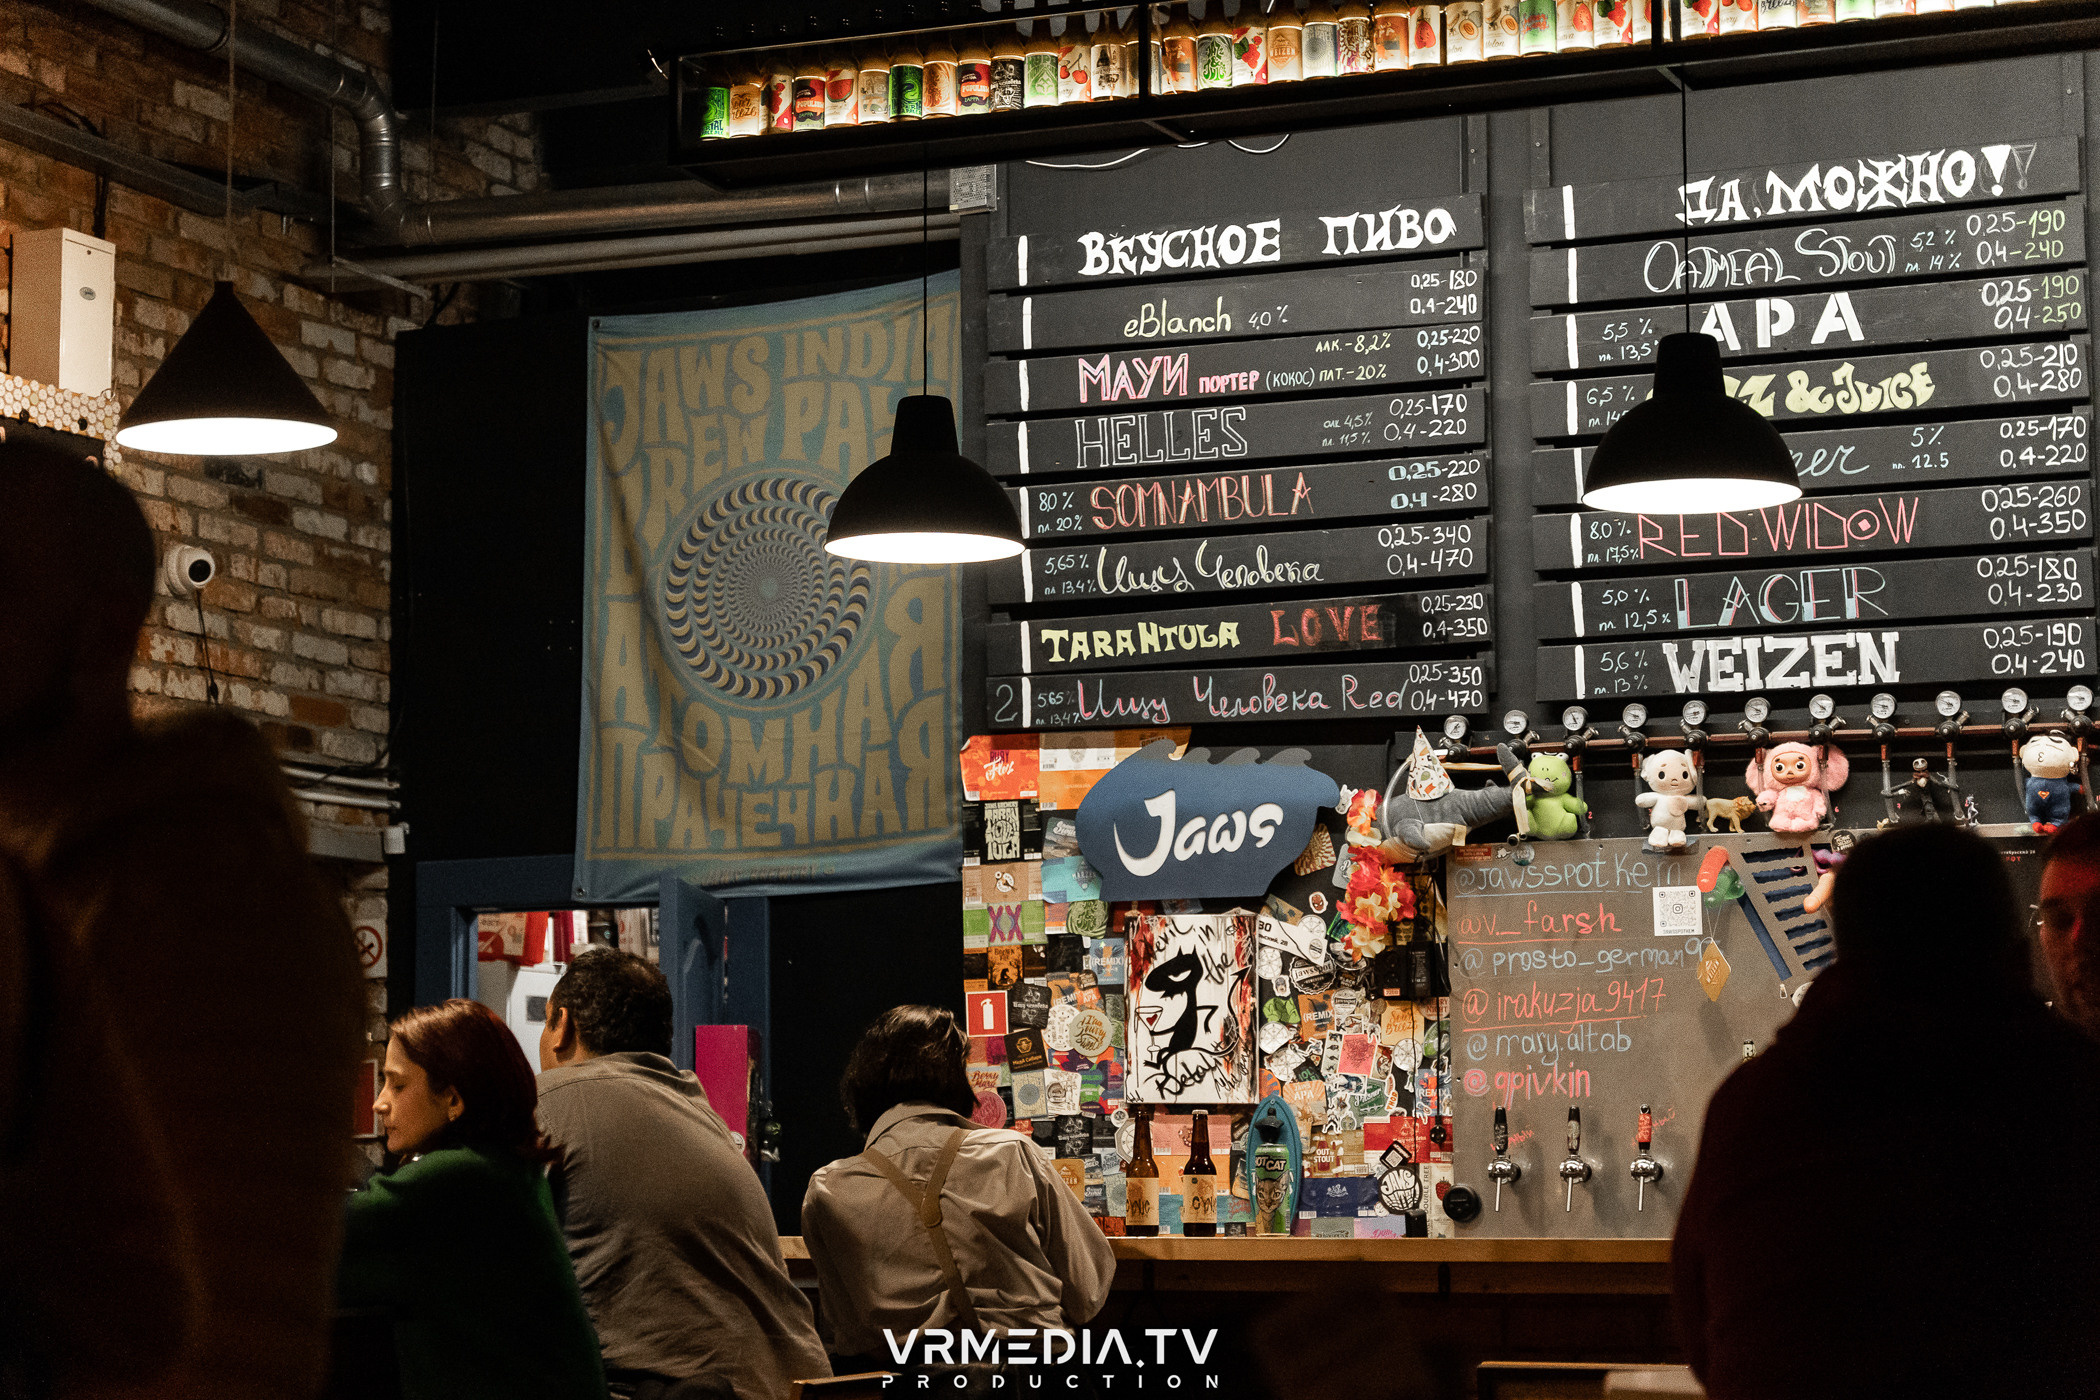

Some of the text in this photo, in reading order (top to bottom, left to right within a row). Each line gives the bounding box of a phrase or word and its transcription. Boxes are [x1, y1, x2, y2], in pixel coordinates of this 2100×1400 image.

[1077, 204, 1457, 276] ВКУСНОЕ ПИВО
[1123, 296, 1231, 337] eBlanch
[603, 337, 771, 476] JAWS
[1079, 353, 1314, 403] МАУИ ПОРТЕР (КОКОС)
[1785, 370, 1834, 413] &
[1076, 407, 1248, 468] HELLES
[1090, 472, 1314, 531] SOMNAMBULA
[1675, 567, 1889, 629] LAGER
[1041, 604, 1384, 663] TARANTULA LOVE
[1662, 632, 1900, 694] WEIZEN
[1113, 788, 1284, 877] Jaws
[1294, 1089, 1315, 1101] APA
[1266, 1159, 1286, 1171] CAT
